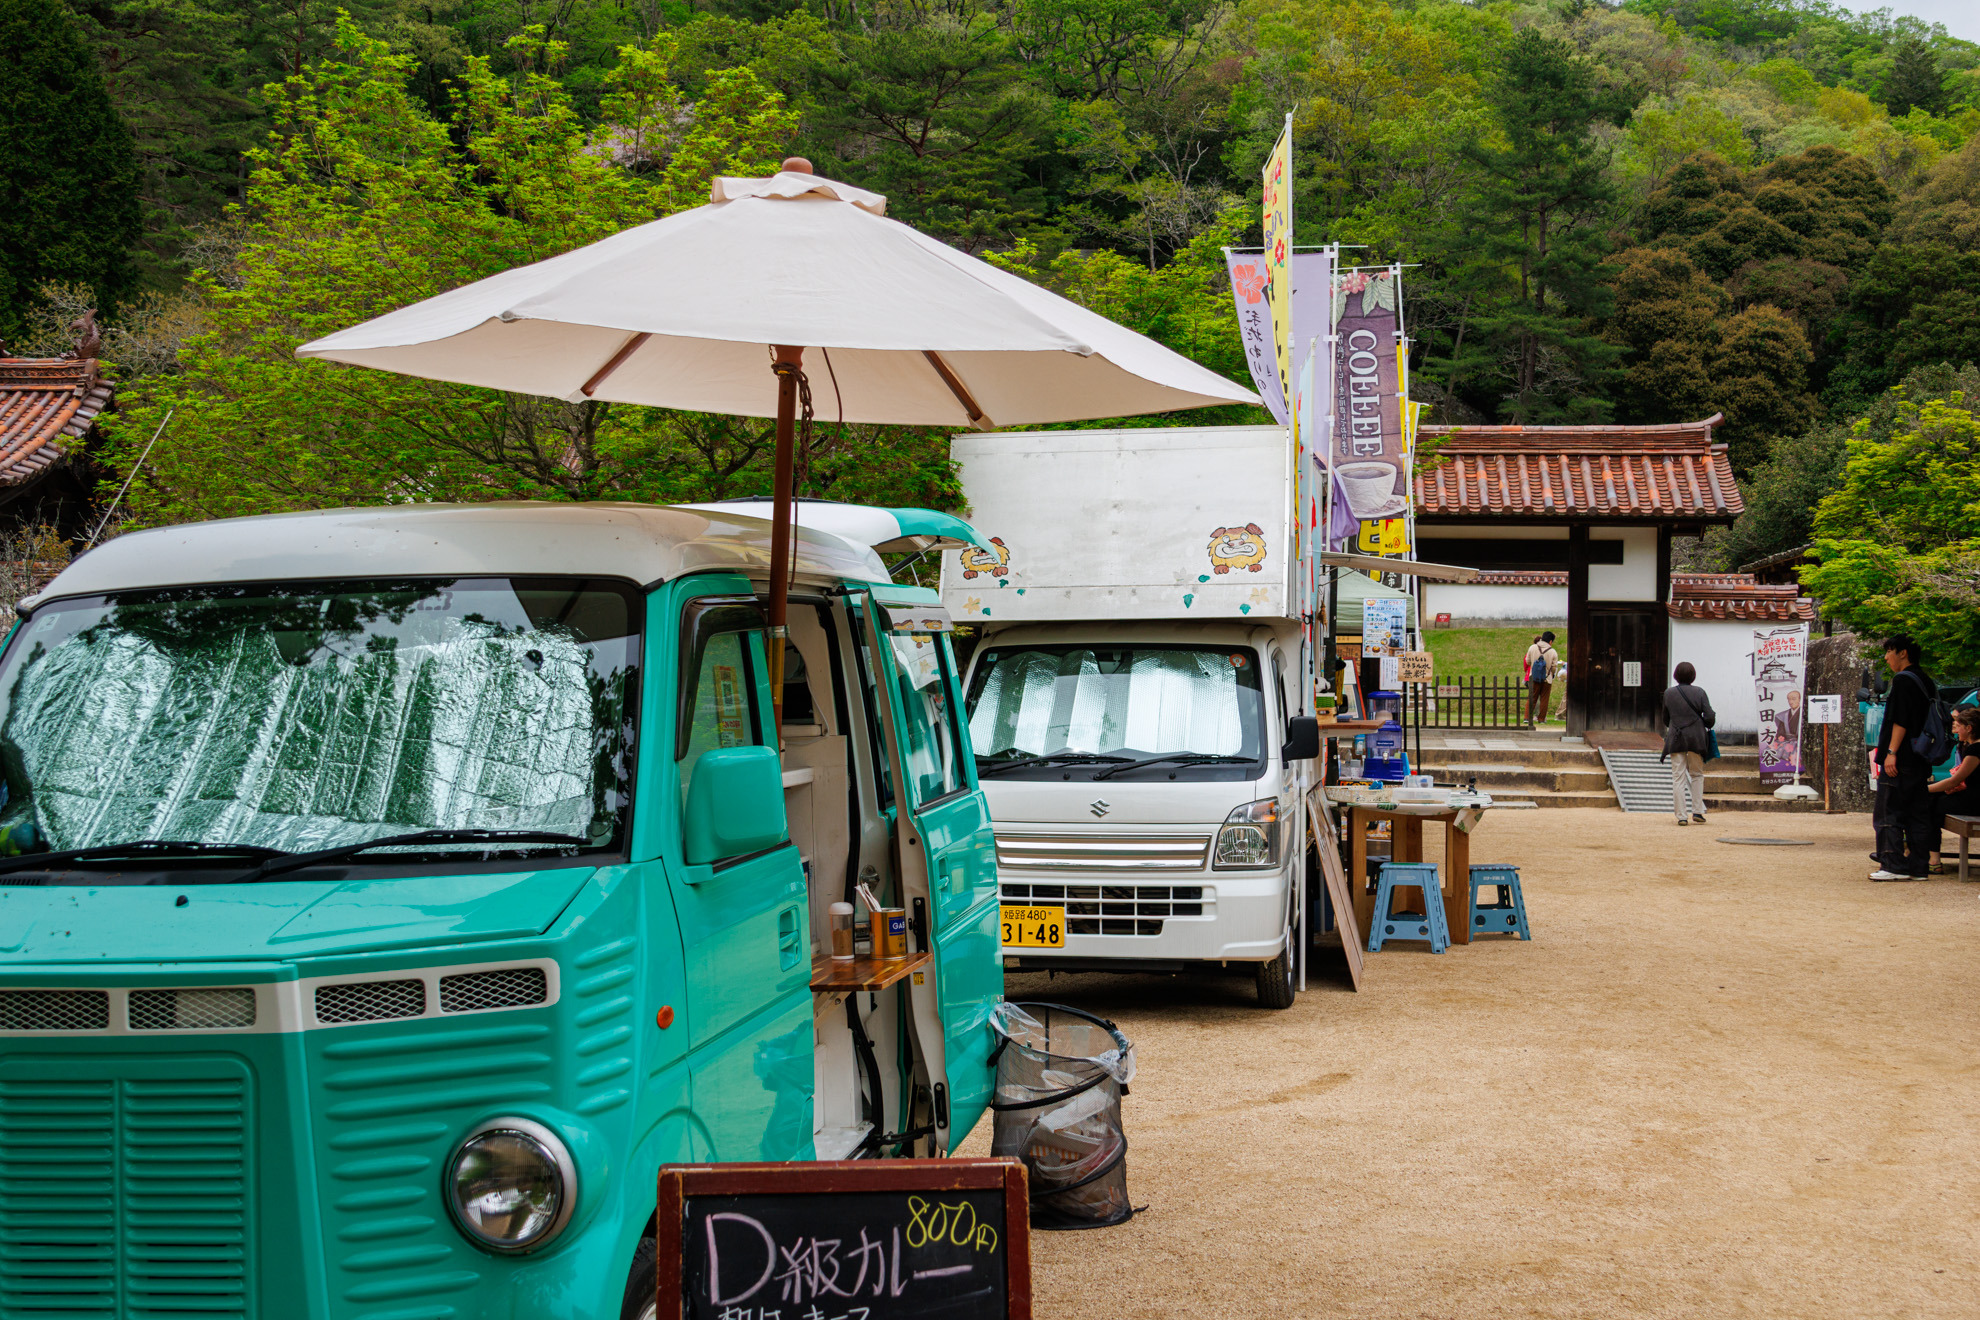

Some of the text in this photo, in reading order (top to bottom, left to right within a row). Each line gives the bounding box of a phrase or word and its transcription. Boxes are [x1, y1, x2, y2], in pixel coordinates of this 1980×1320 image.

[1403, 669, 1426, 679] 無料
[1821, 703, 1829, 722] 受付
[1758, 686, 1780, 767] 山田方谷
[1004, 909, 1047, 920] 姫路 480
[1002, 922, 1059, 944] 31-48
[906, 1195, 998, 1254] 800円
[706, 1212, 974, 1305] D級カレー
